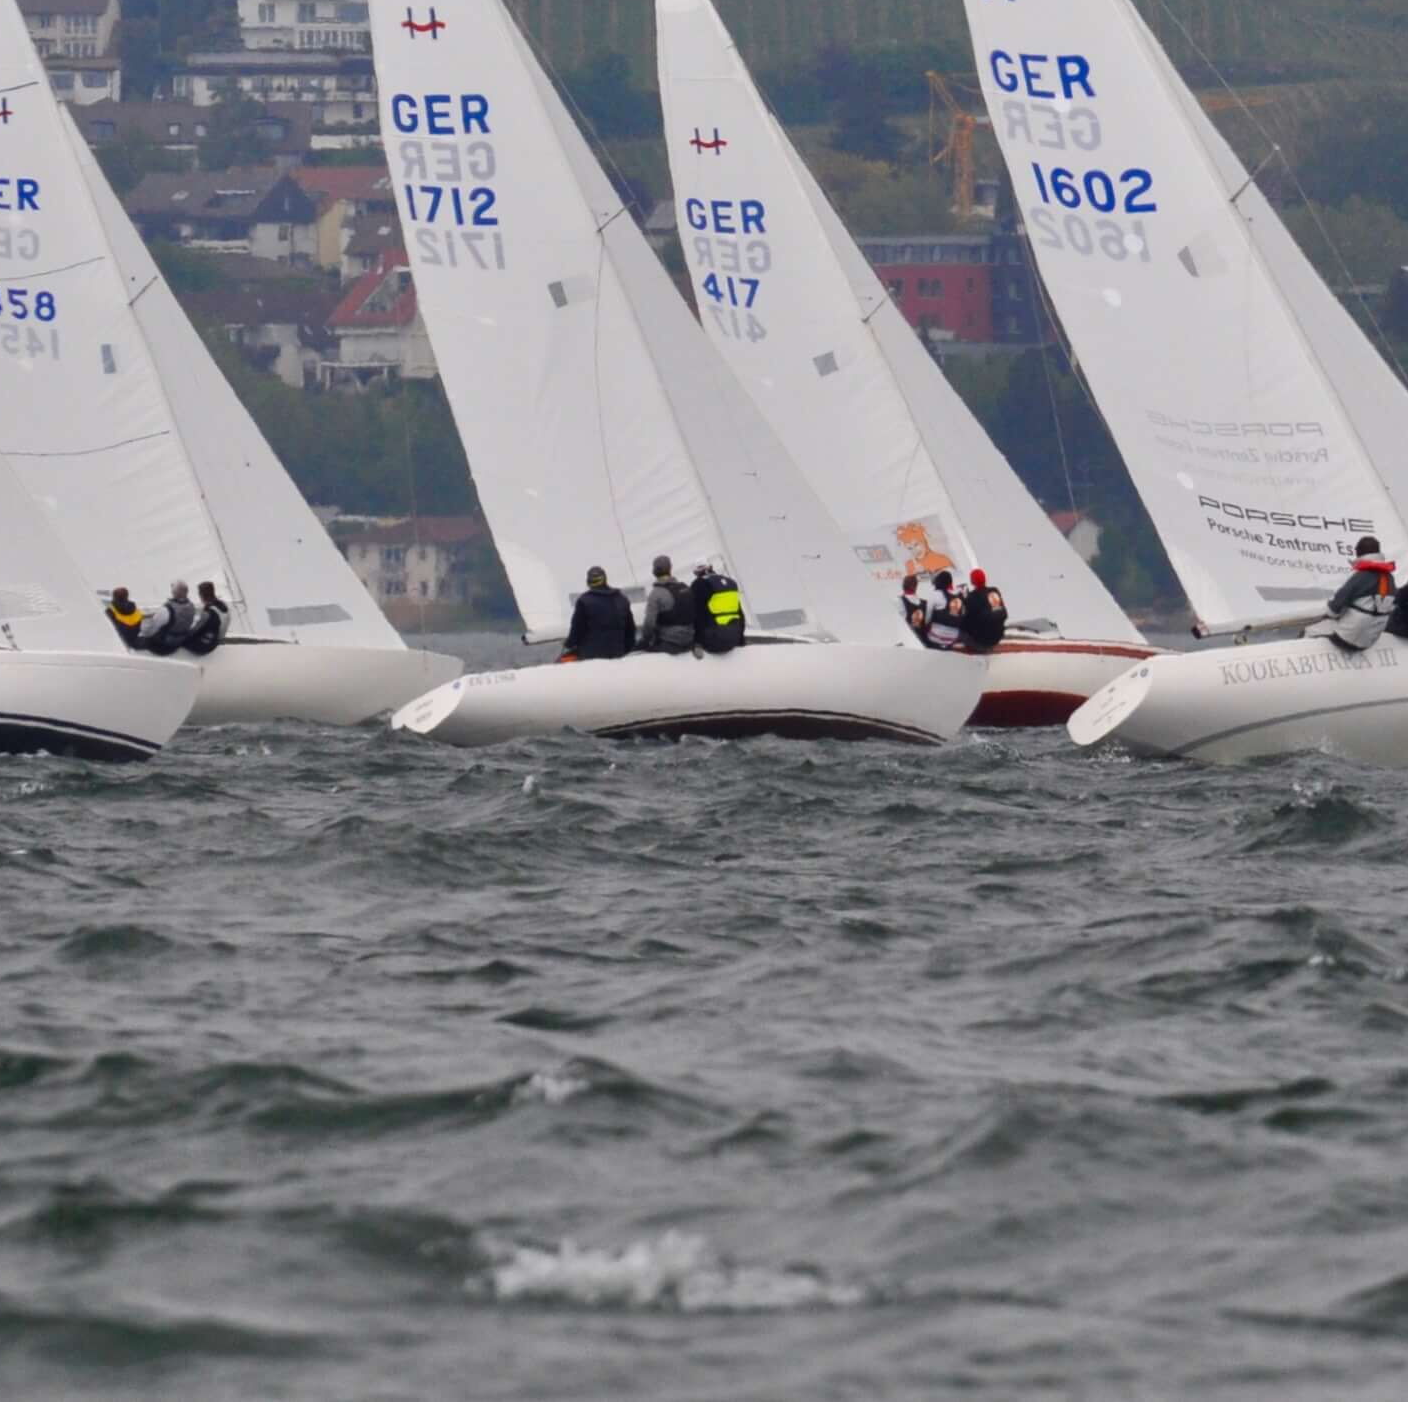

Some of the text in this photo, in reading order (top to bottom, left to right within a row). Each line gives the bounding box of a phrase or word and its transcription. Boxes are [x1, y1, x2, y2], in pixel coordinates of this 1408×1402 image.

[989, 49, 1097, 101] GER
[391, 93, 492, 136] GER
[405, 185, 499, 228] 1712
[1031, 162, 1158, 215] 1602
[686, 197, 767, 235] GER
[702, 272, 760, 309] 417
[1198, 495, 1376, 533] PORSCHE
[1206, 517, 1356, 556] Porsche Zentrum Es
[1217, 652, 1373, 686] KOOKABURRA
